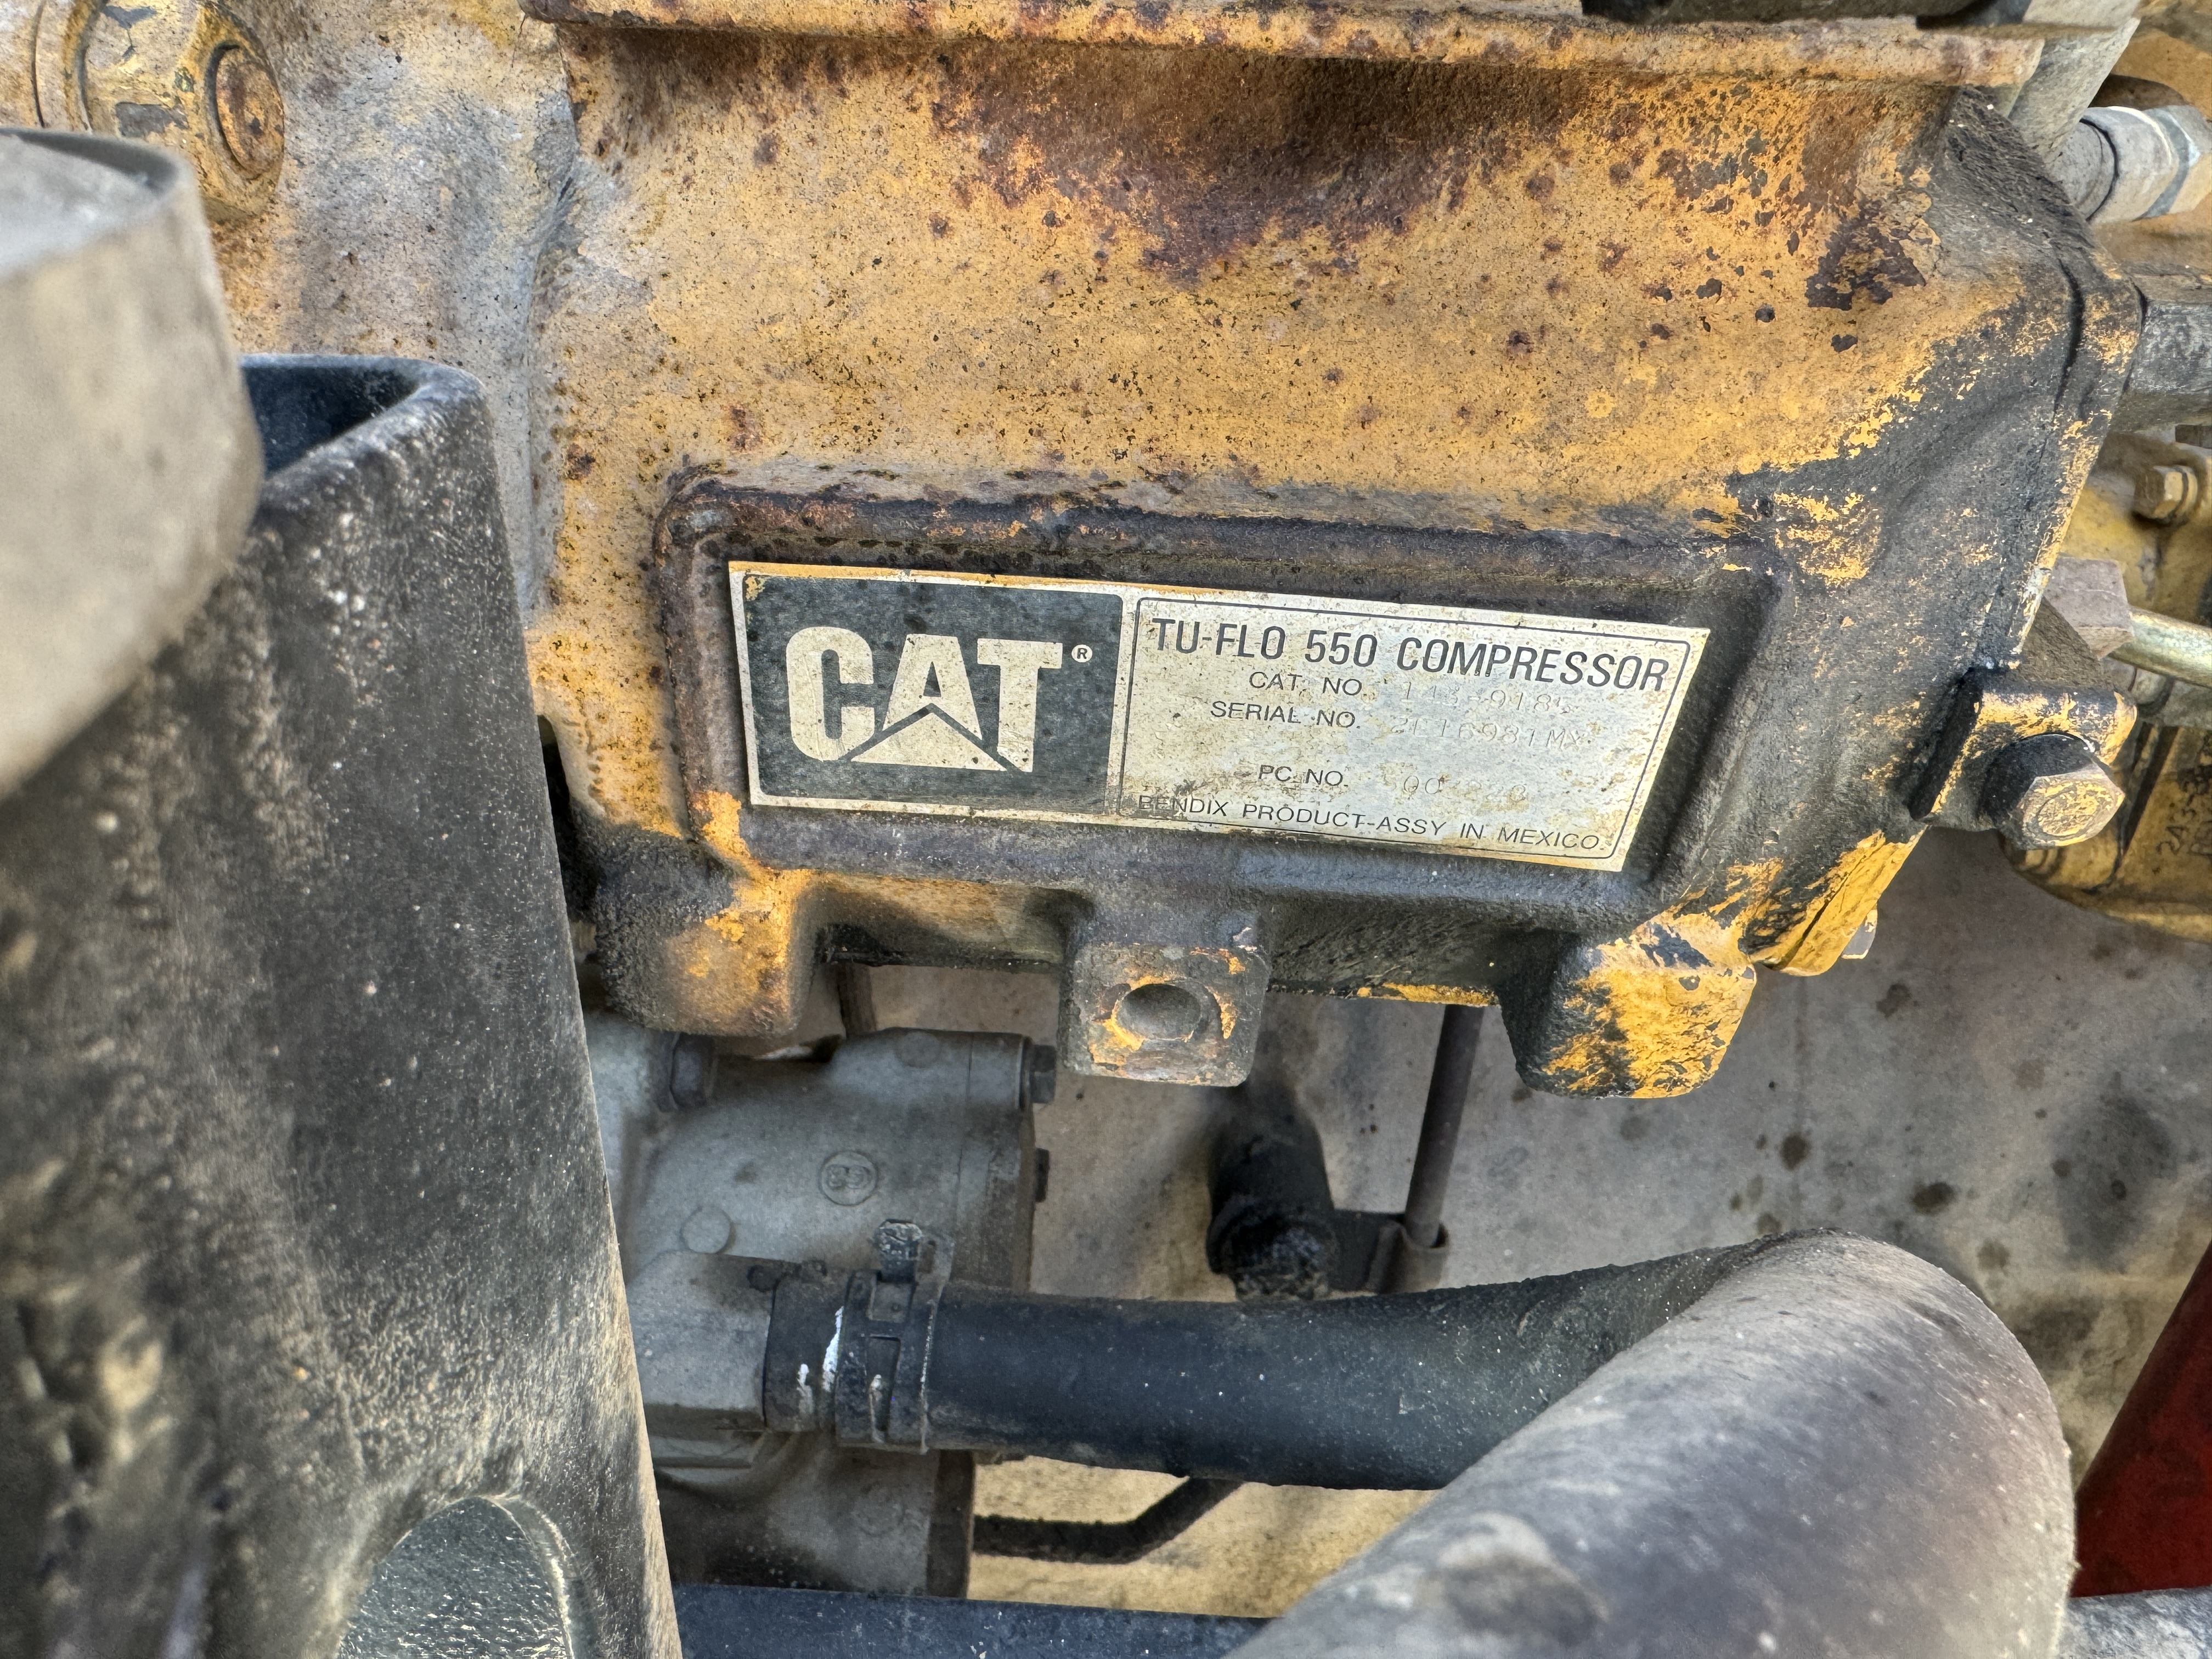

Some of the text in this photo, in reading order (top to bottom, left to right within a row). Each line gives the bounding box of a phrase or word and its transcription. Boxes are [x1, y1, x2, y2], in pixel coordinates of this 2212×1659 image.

[1152, 617, 1669, 692] TU-FLO 550 COMPRESSOR
[1210, 700, 1301, 724] SERIAL
[1316, 709, 1361, 729] NO.
[1138, 794, 1229, 817] BENDIX
[1242, 803, 1447, 837] PRODUCT-ASSY
[1459, 822, 1484, 839] IN
